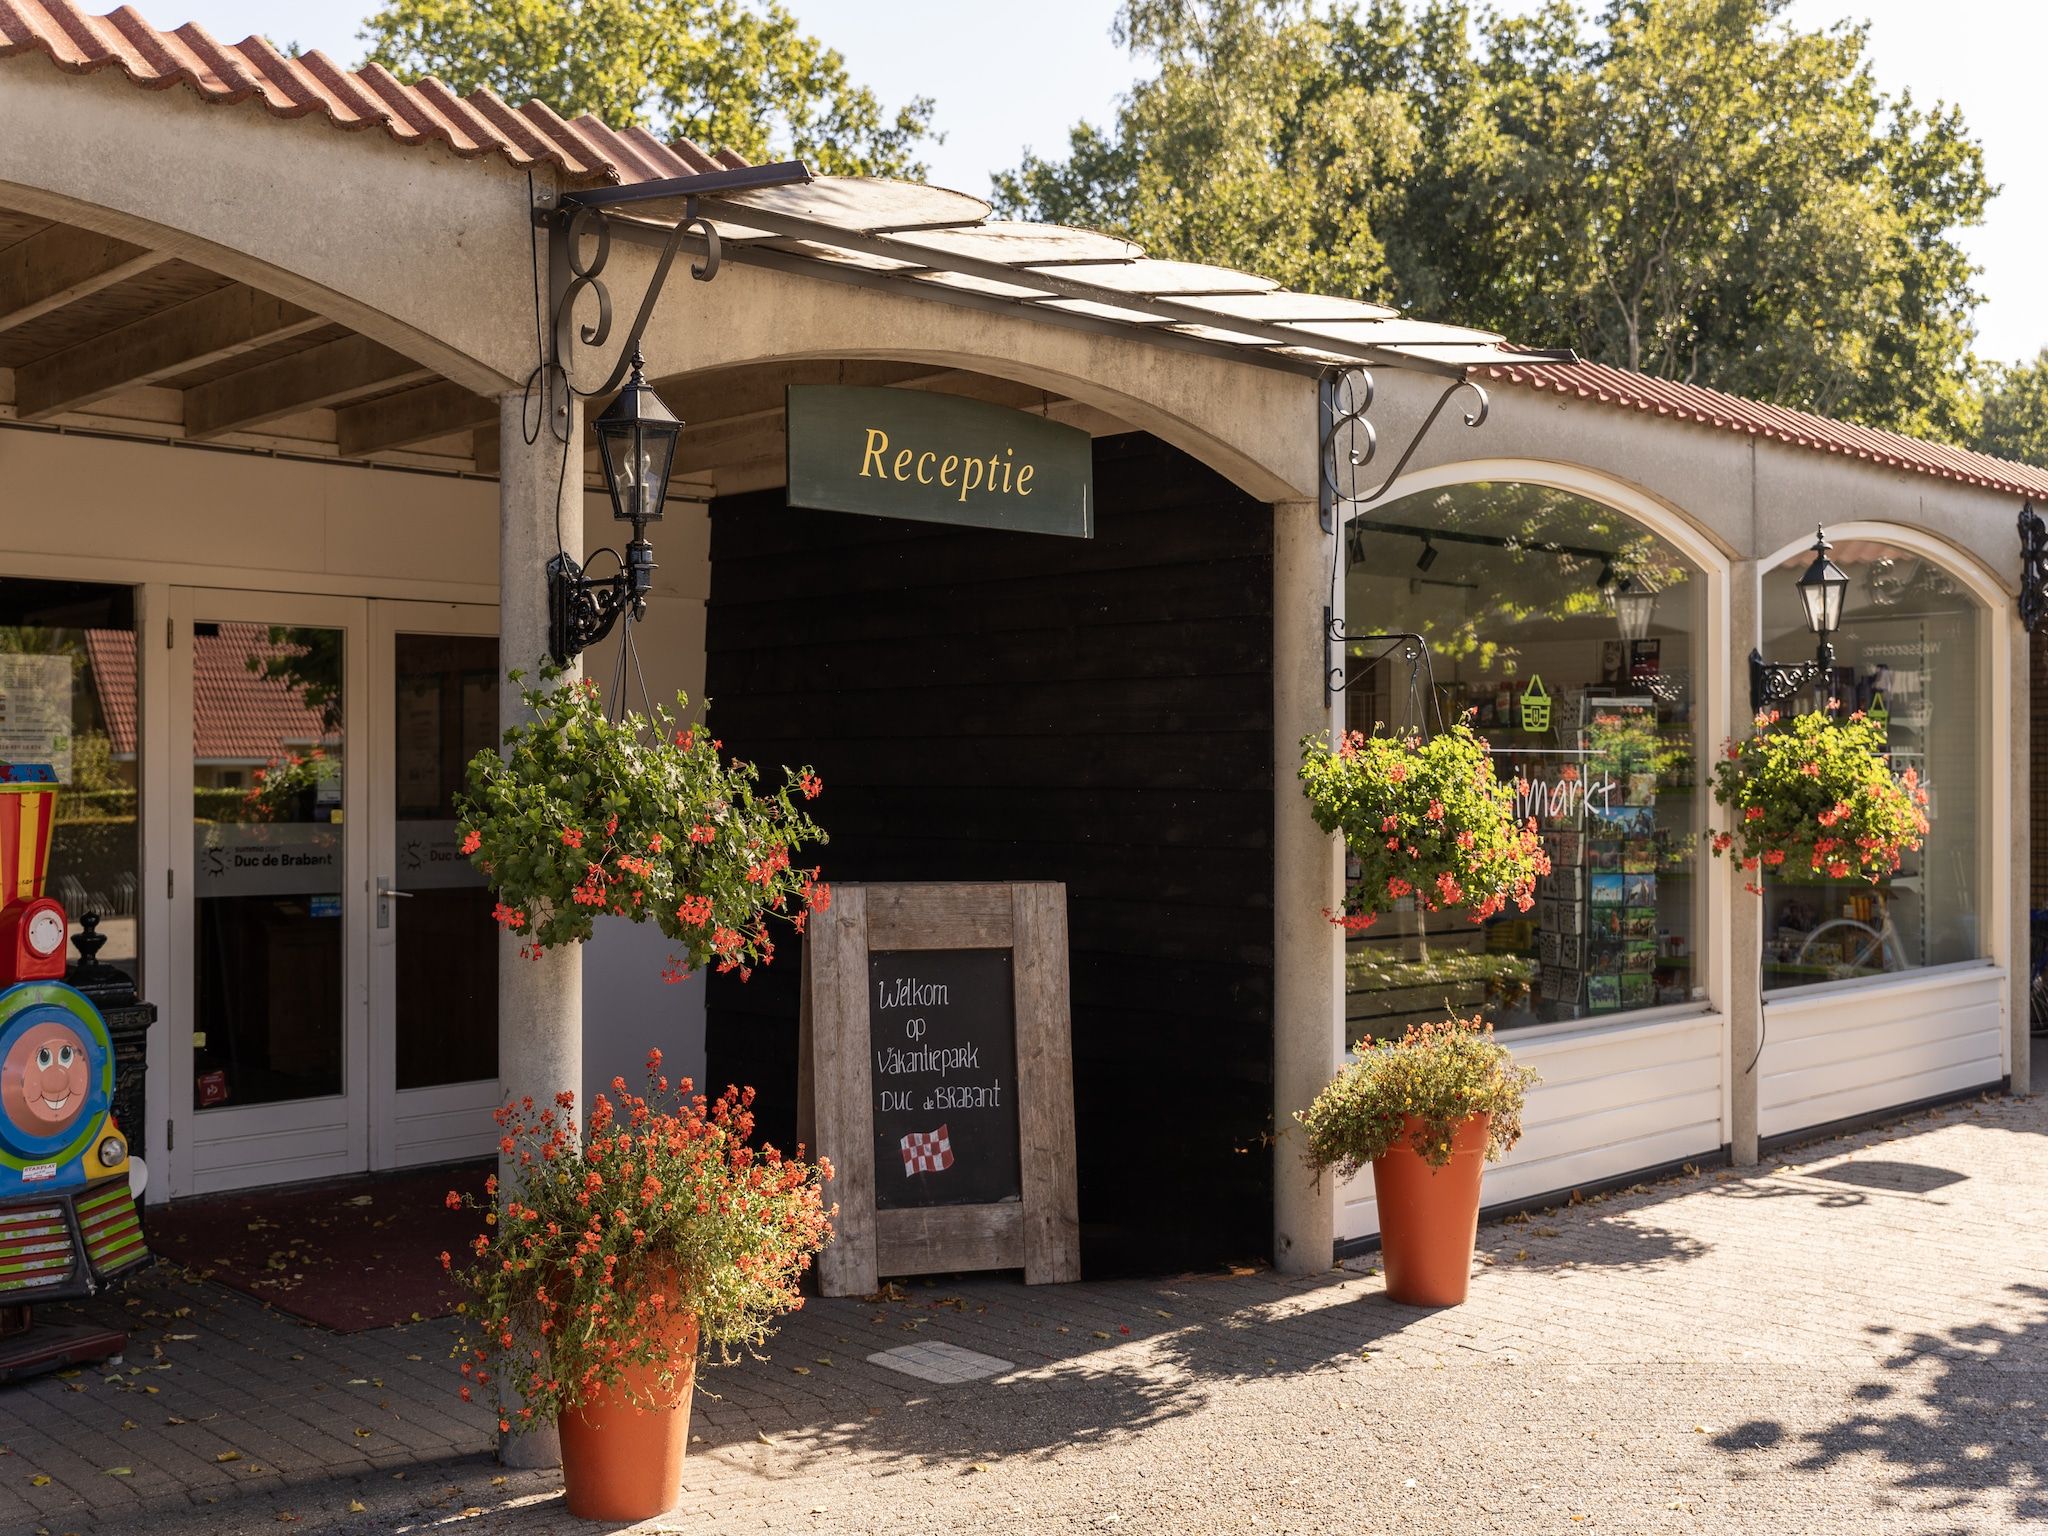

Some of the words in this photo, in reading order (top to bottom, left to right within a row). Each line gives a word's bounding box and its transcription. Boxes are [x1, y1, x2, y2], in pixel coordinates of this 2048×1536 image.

[858, 427, 1035, 502] Receptie
[235, 855, 260, 867] Duc
[262, 854, 279, 866] de
[282, 853, 333, 866] Brabant
[430, 850, 451, 861] Duc
[879, 978, 949, 1009] Welkom
[906, 1018, 926, 1042] op
[880, 1090, 914, 1112] DUC
[923, 1096, 935, 1110] de
